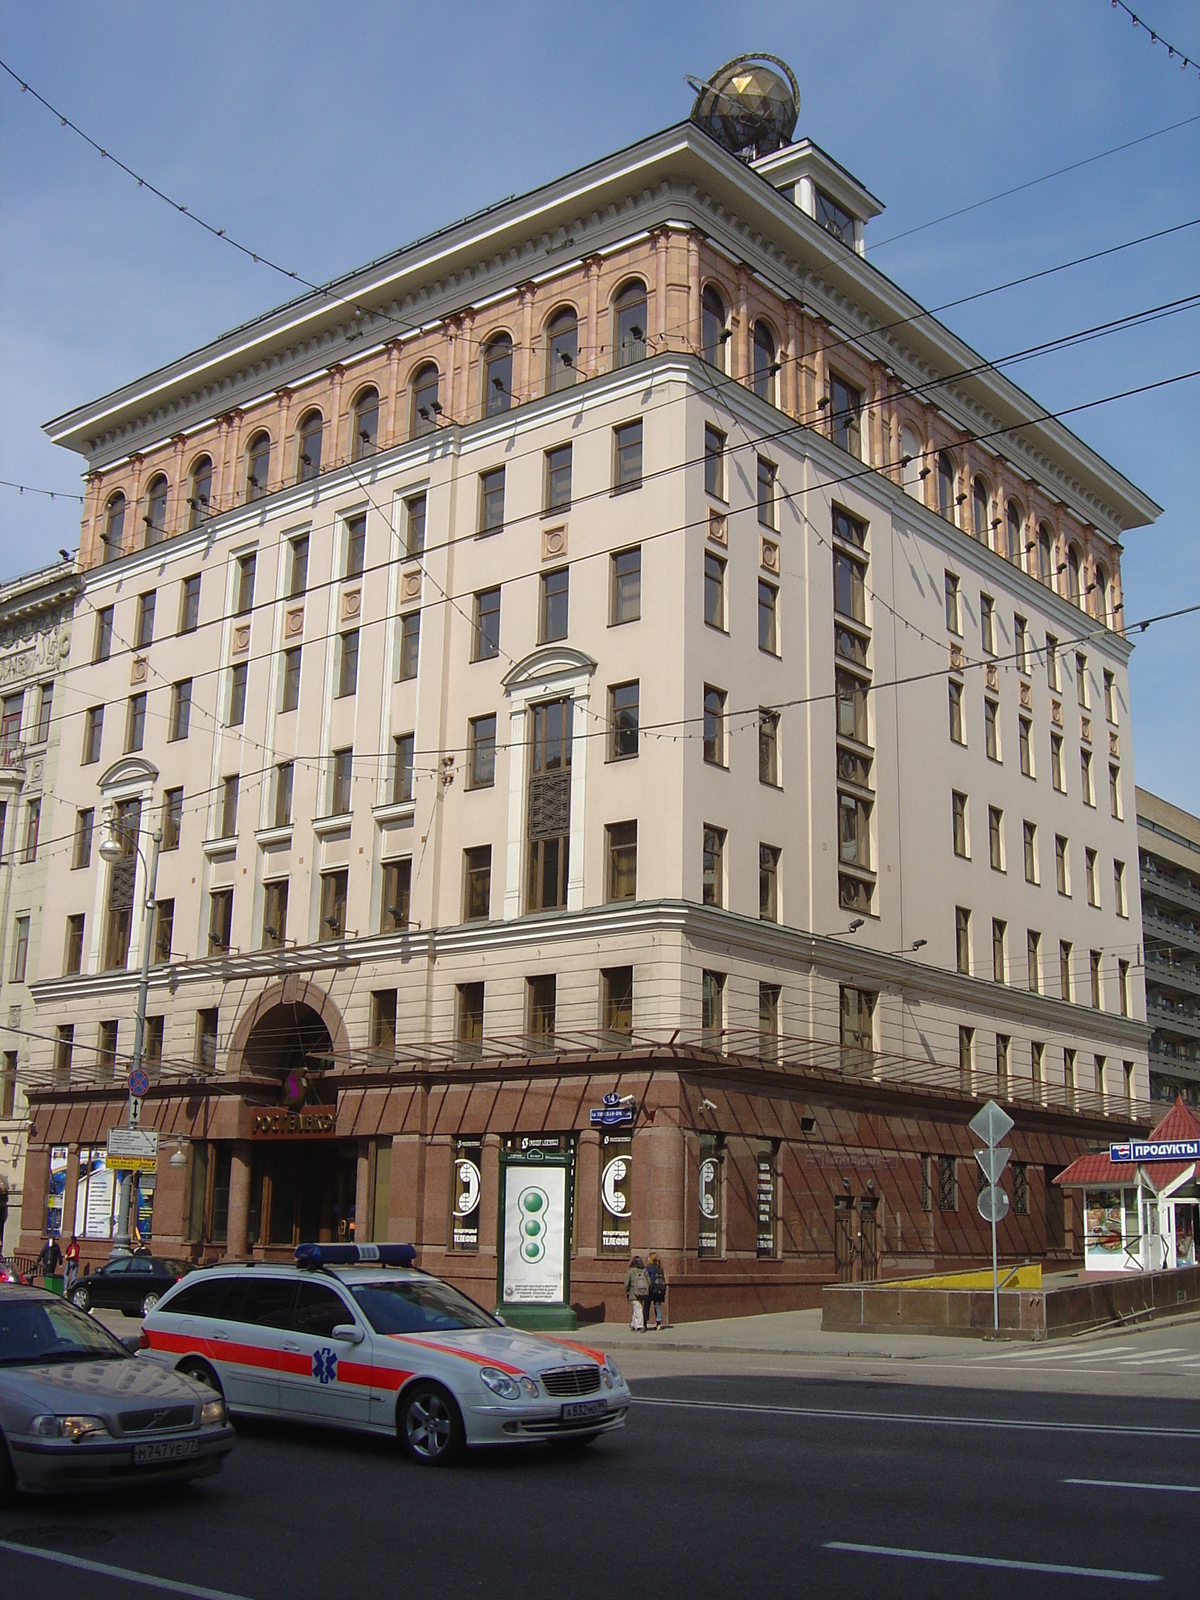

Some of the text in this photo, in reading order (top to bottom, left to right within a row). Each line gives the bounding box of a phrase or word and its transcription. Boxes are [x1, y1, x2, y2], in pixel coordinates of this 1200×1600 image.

[607, 1094, 615, 1102] 14
[252, 1114, 337, 1133] РОСТЕЛЕКО
[1135, 1143, 1198, 1157] ПРОДУКТЫ
[454, 1234, 477, 1243] ТЕЛЕФОН
[603, 1237, 629, 1246] ТЕЛЕФОН
